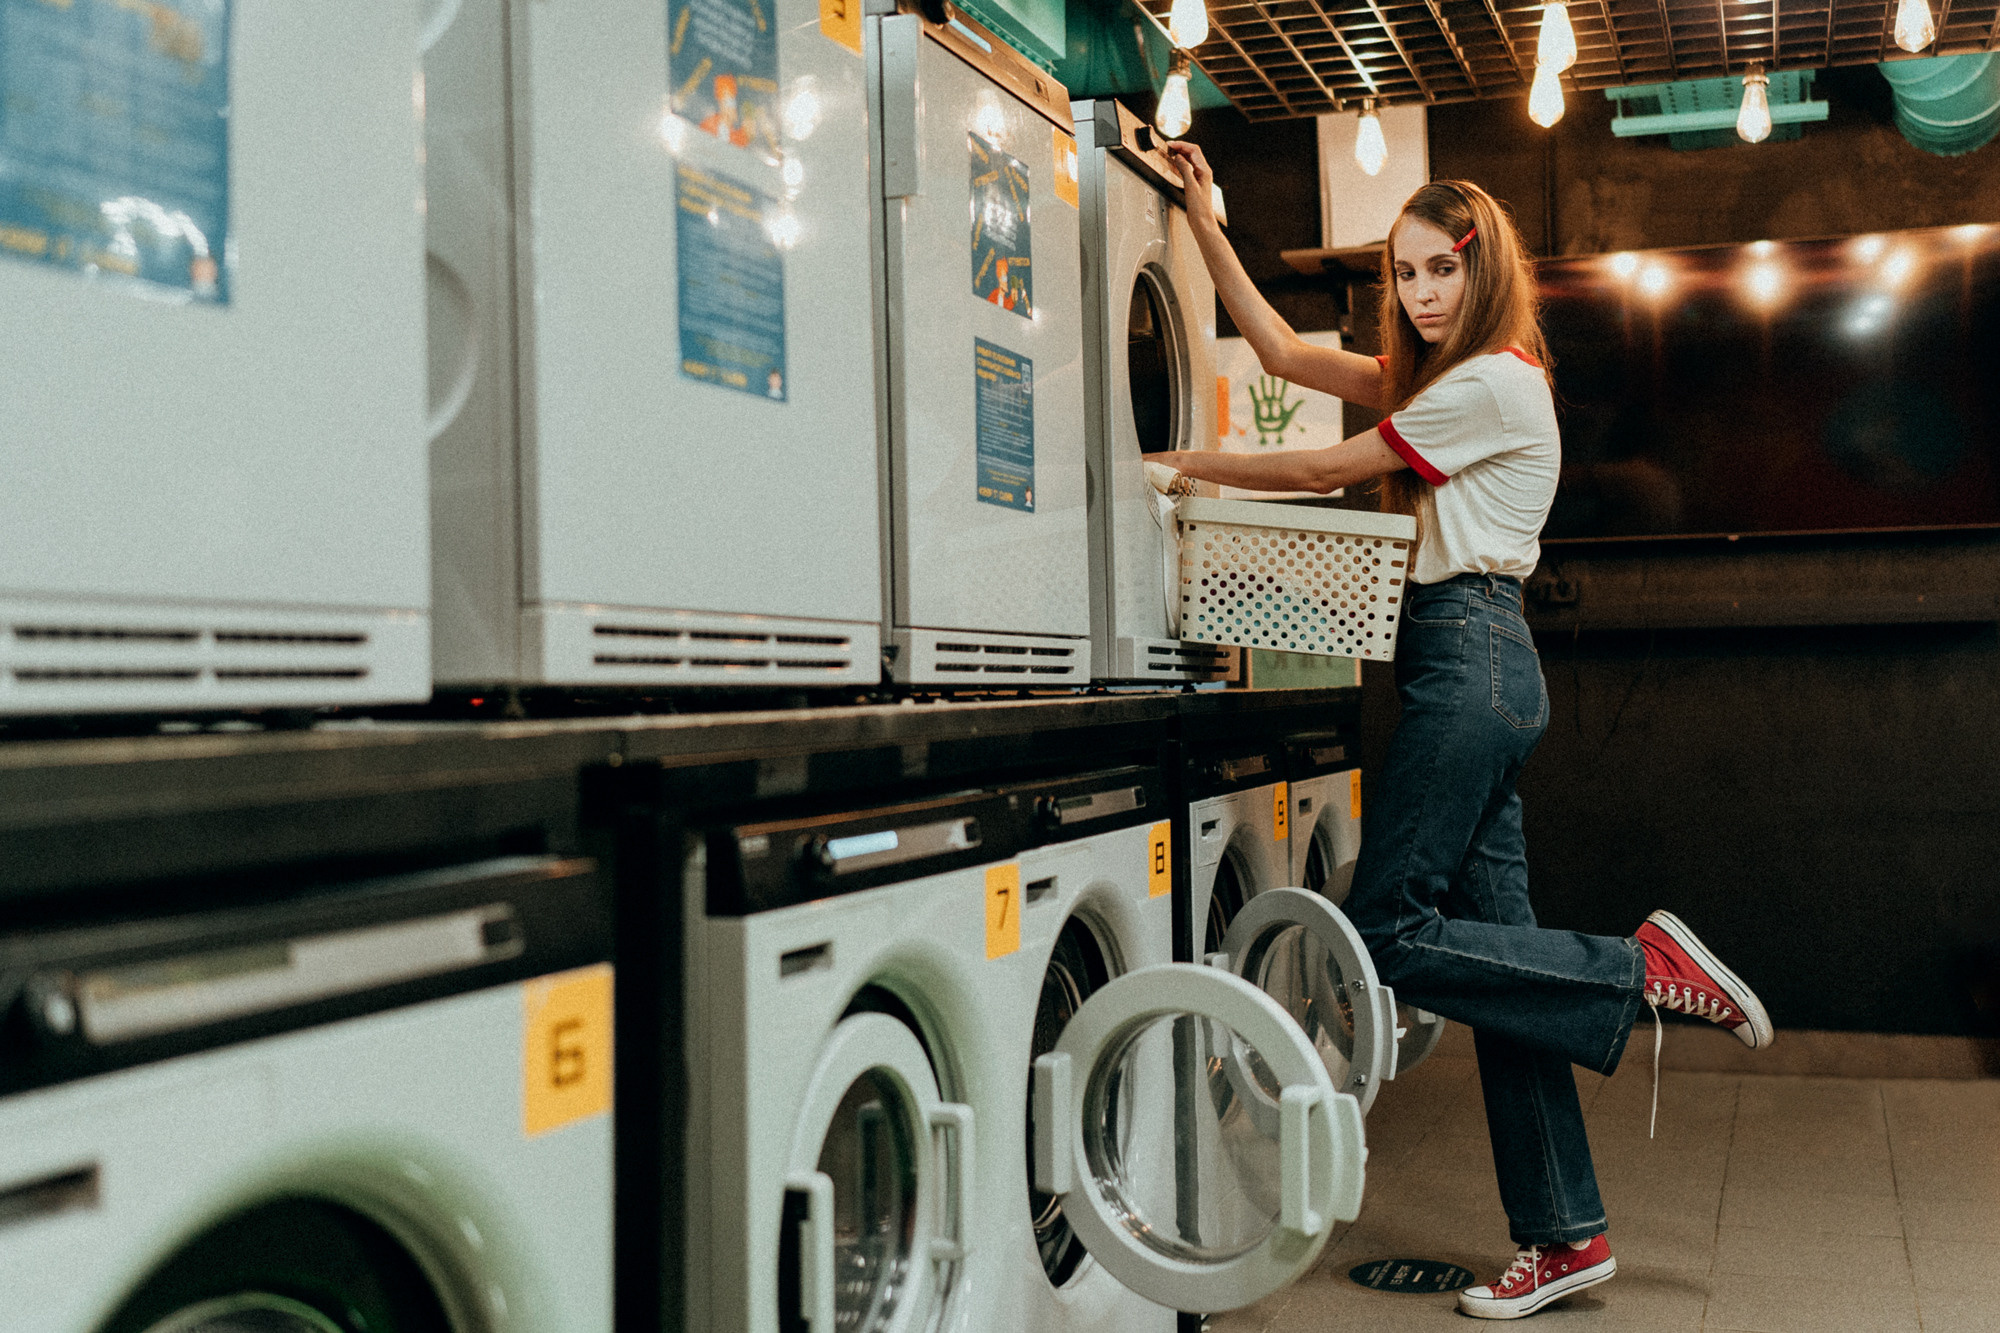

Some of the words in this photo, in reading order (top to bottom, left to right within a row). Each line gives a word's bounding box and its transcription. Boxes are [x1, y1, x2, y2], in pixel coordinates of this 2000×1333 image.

[1279, 801, 1284, 825] 9
[1155, 841, 1165, 874] 8
[997, 889, 1009, 931] 7
[550, 1017, 586, 1088] 6
